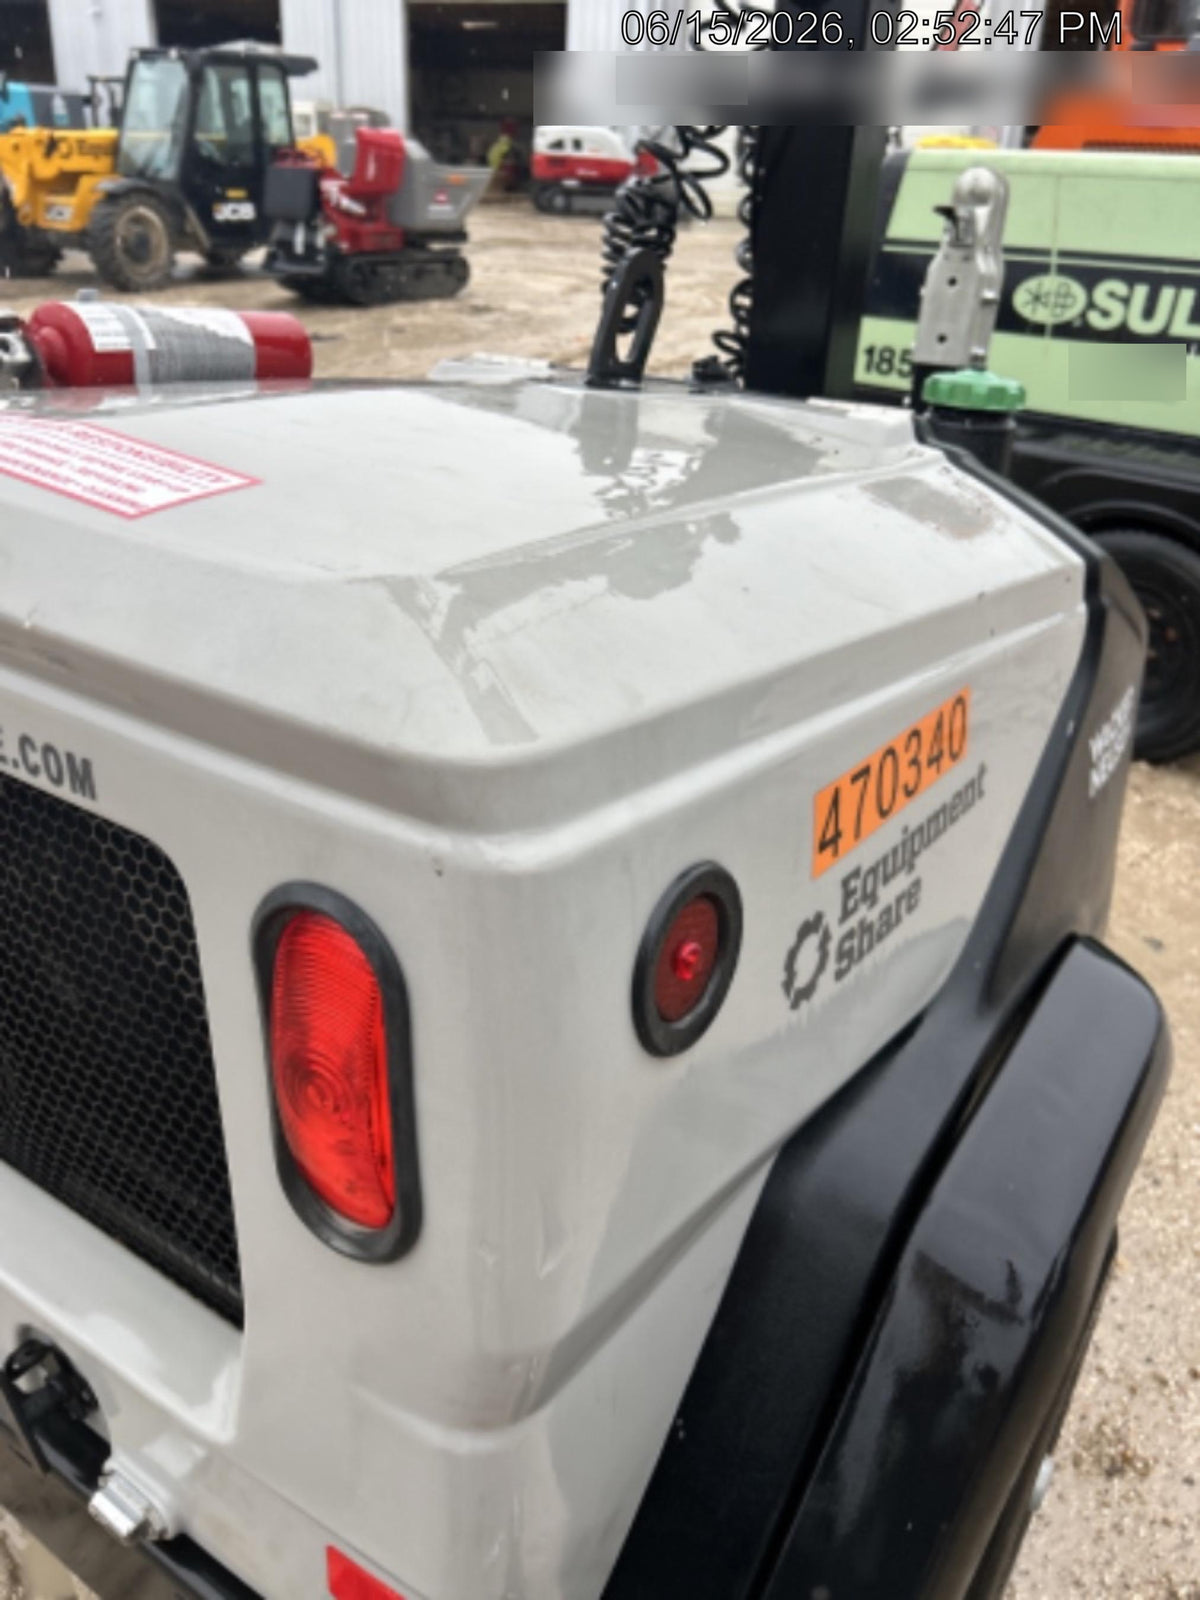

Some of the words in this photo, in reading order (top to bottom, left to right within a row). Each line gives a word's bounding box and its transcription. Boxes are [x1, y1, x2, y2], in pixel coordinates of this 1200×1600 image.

[1086, 278, 1200, 337] SUL
[818, 696, 967, 858] 470340
[838, 762, 986, 925] Equipment
[834, 876, 922, 982] Share
